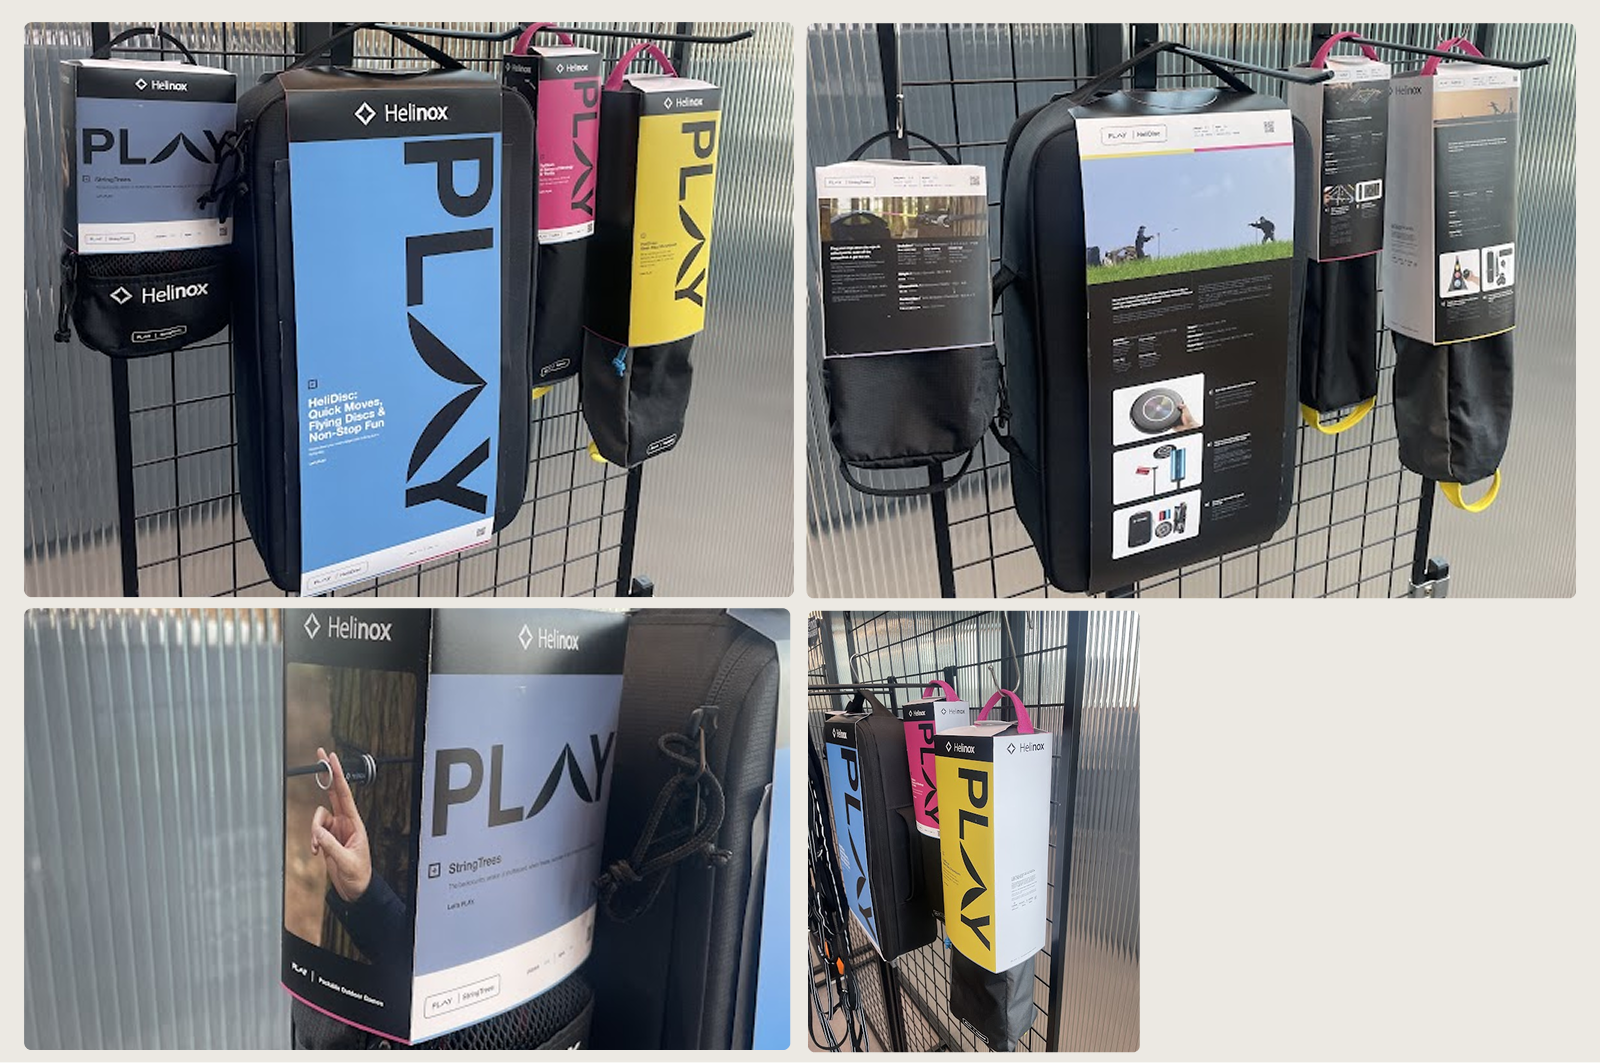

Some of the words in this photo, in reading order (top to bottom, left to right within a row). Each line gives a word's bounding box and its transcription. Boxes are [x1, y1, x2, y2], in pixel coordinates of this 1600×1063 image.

[566, 63, 589, 72] Helinox
[151, 78, 188, 92] Helinox
[1395, 85, 1422, 96] Helinox
[384, 103, 449, 123] Helinox
[675, 97, 703, 109] Helinox
[82, 128, 230, 166] PLAY
[571, 79, 599, 217] PLAY
[674, 120, 717, 308] PLAY
[141, 281, 209, 304] Helinox
[403, 137, 494, 516] PLAY
[308, 391, 358, 409] HeliDisc:
[308, 405, 342, 420] Quick
[344, 398, 383, 413] Moves,
[308, 417, 342, 432] Flying
[345, 411, 376, 424] Discs
[377, 406, 386, 417] &
[309, 425, 362, 443] Non-Stop
[364, 419, 385, 431] Fun
[328, 615, 393, 643] Helinox
[538, 628, 579, 651] Helinox
[953, 742, 976, 754] Helinox
[1019, 742, 1045, 753] Helinox
[431, 730, 616, 838] PLAY
[840, 747, 878, 943] PLAY
[448, 854, 502, 874] StringTrees
[957, 767, 991, 952] PLAY
[431, 997, 454, 1010] PLAY
